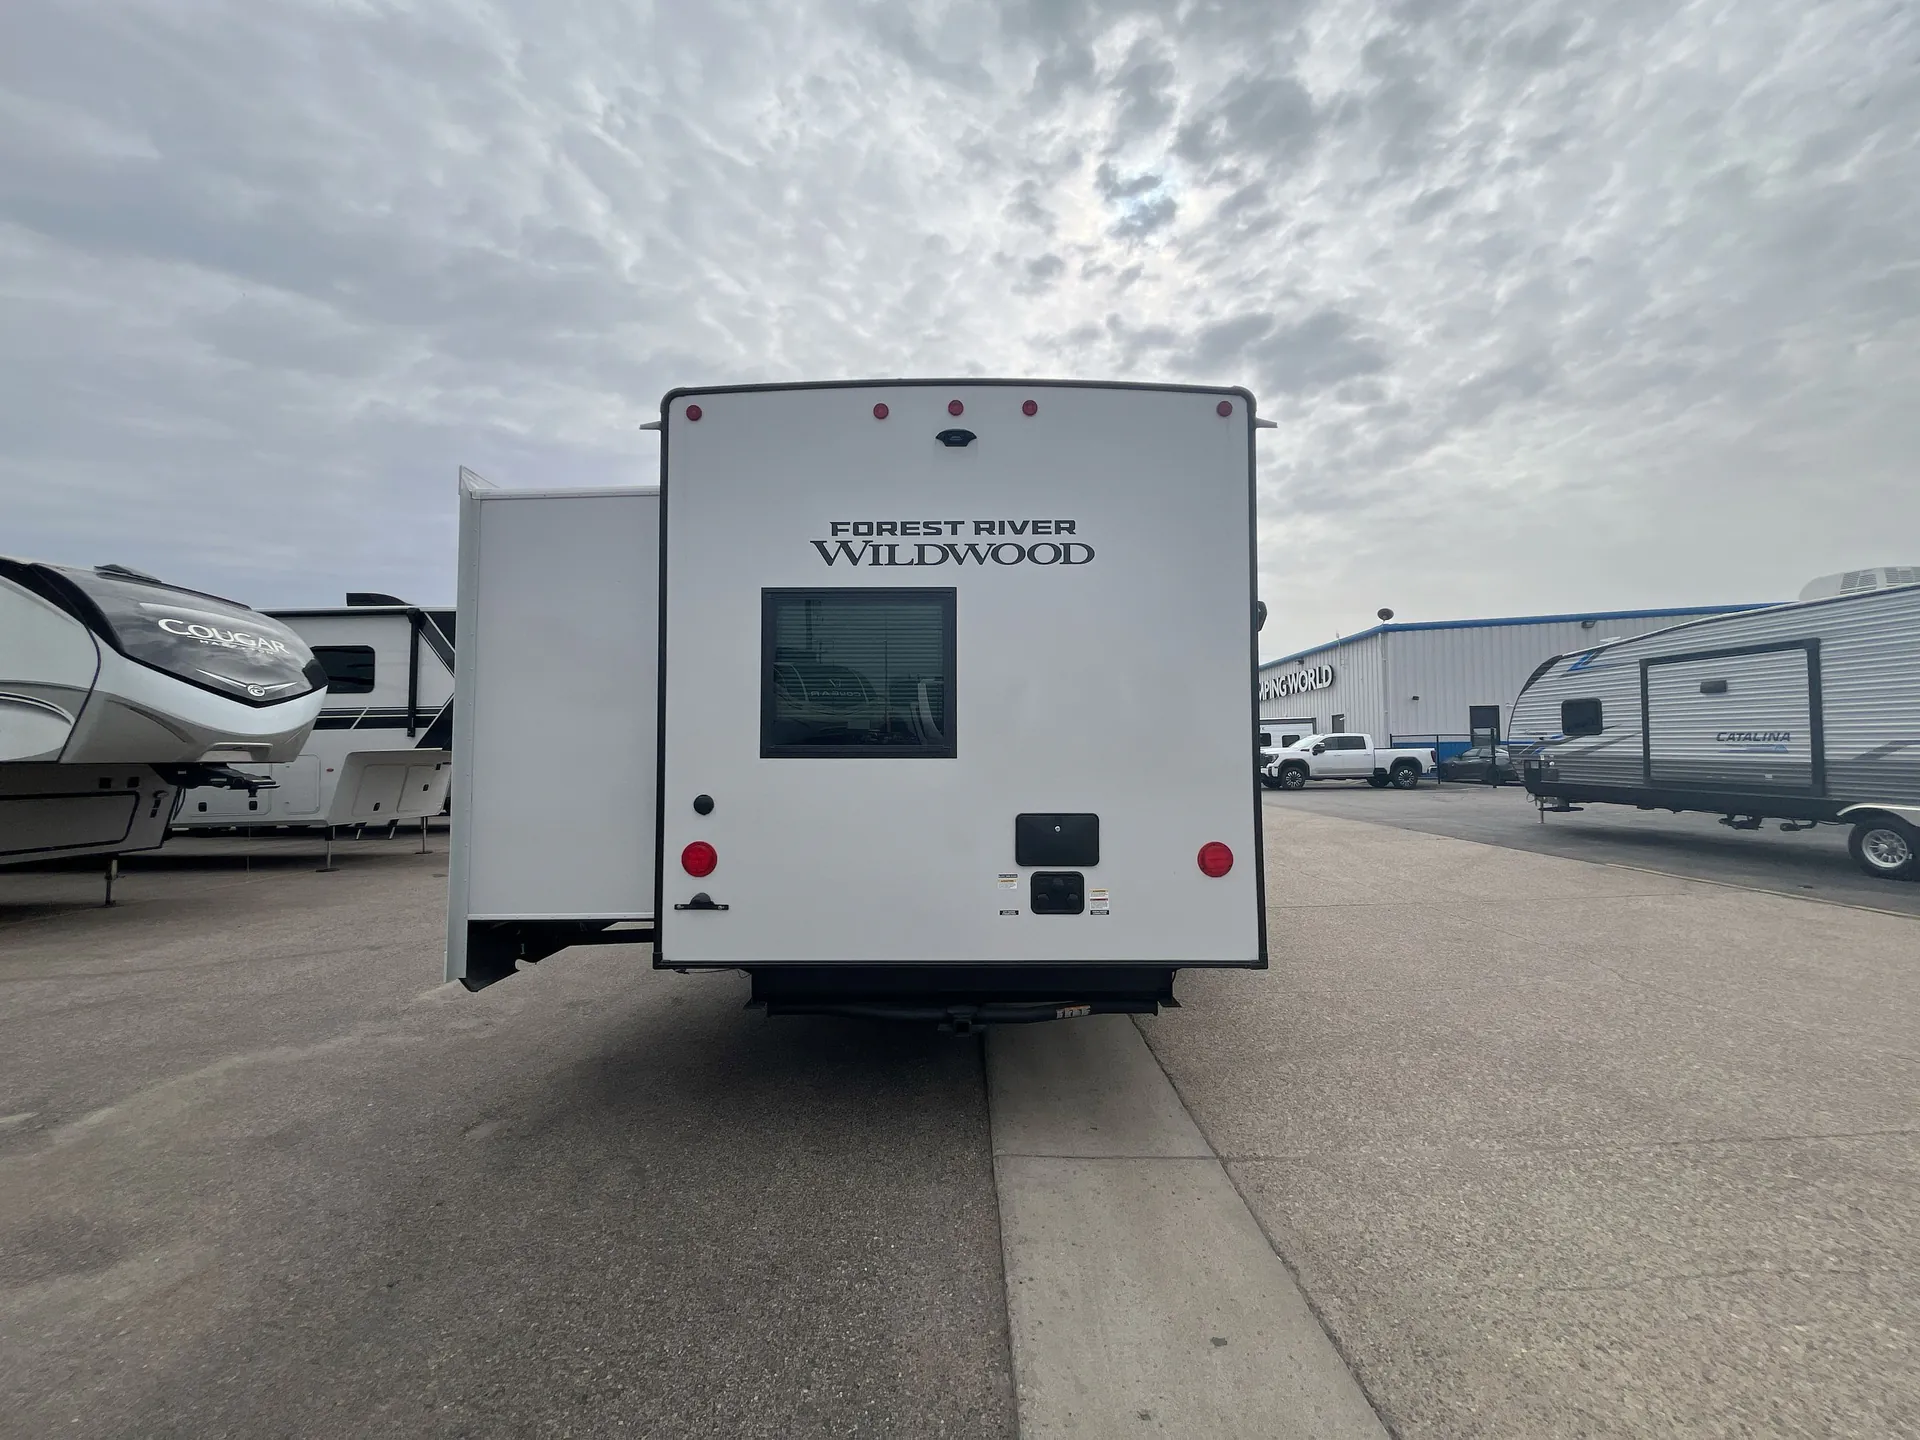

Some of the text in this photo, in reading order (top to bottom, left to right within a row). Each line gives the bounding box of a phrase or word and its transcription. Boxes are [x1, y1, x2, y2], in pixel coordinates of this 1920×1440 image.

[829, 519, 1076, 536] FOREST RIVER
[809, 540, 1096, 566] WILDWOOD
[158, 618, 290, 655] COUGAR
[1287, 664, 1333, 694] WORLD
[1716, 732, 1791, 742] CATALINA
